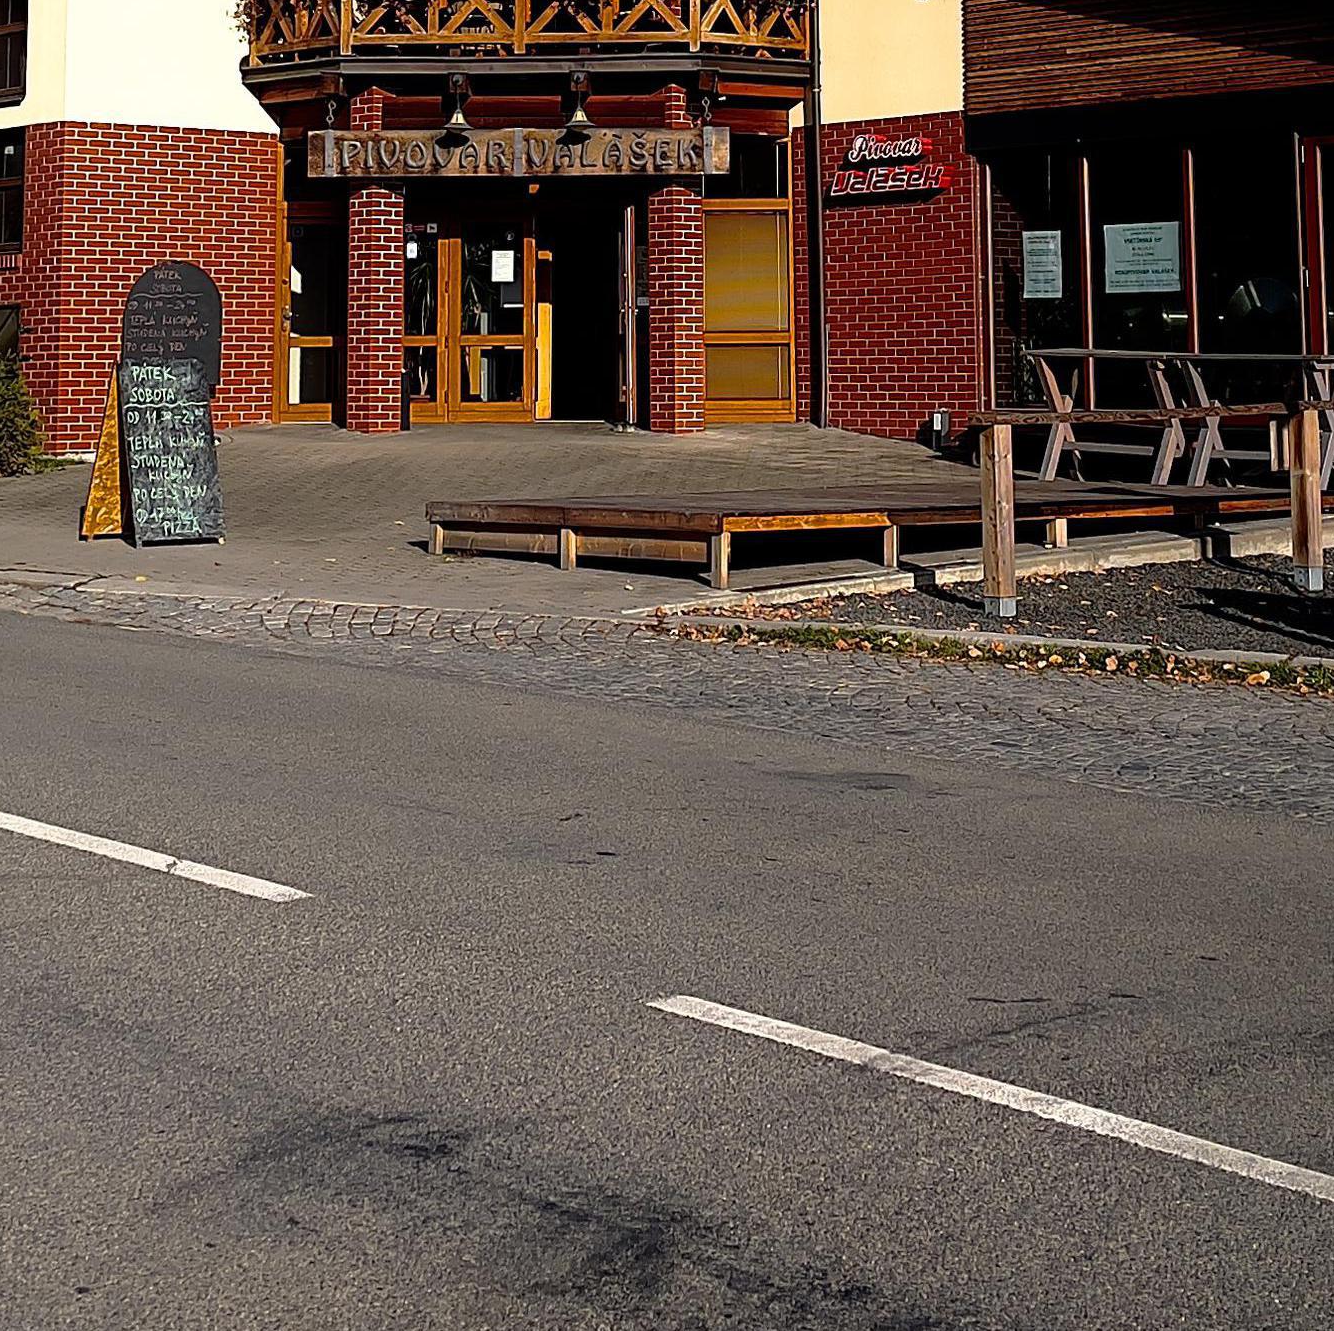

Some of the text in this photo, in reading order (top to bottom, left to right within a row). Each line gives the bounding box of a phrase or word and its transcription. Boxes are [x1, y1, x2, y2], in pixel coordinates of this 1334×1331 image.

[341, 132, 698, 169] PIVOVAR VALÁŠEK
[848, 134, 924, 163] Pivovar
[130, 362, 177, 382] PÁTEK
[130, 387, 175, 403] SOBOTA
[127, 411, 140, 425] OD
[127, 431, 164, 452] TEPLÁ
[131, 451, 186, 469] STUDENÁ
[133, 488, 147, 504] PO
[183, 485, 207, 499] DEN
[162, 516, 203, 536] PIZZA
